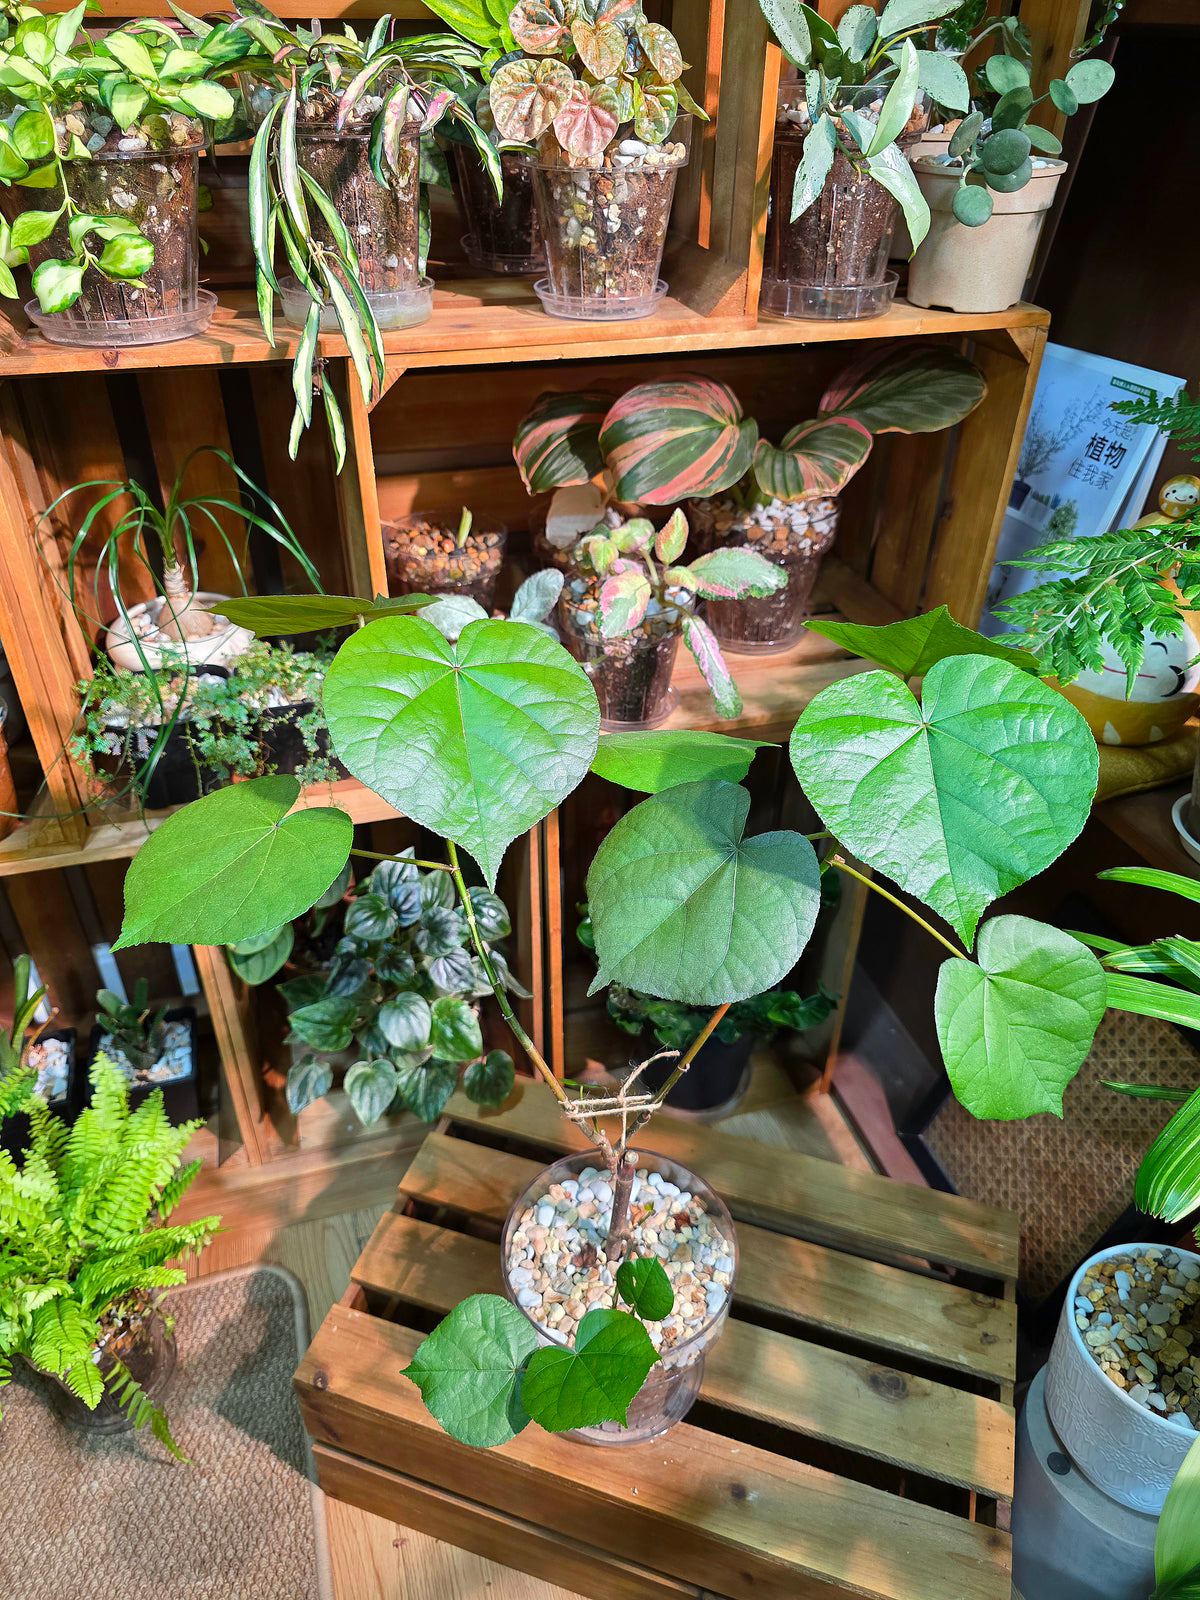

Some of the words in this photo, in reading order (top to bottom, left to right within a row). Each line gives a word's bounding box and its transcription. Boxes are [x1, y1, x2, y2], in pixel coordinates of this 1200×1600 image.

[1085, 433, 1127, 469] 植物
[1068, 457, 1113, 489] 住我家
